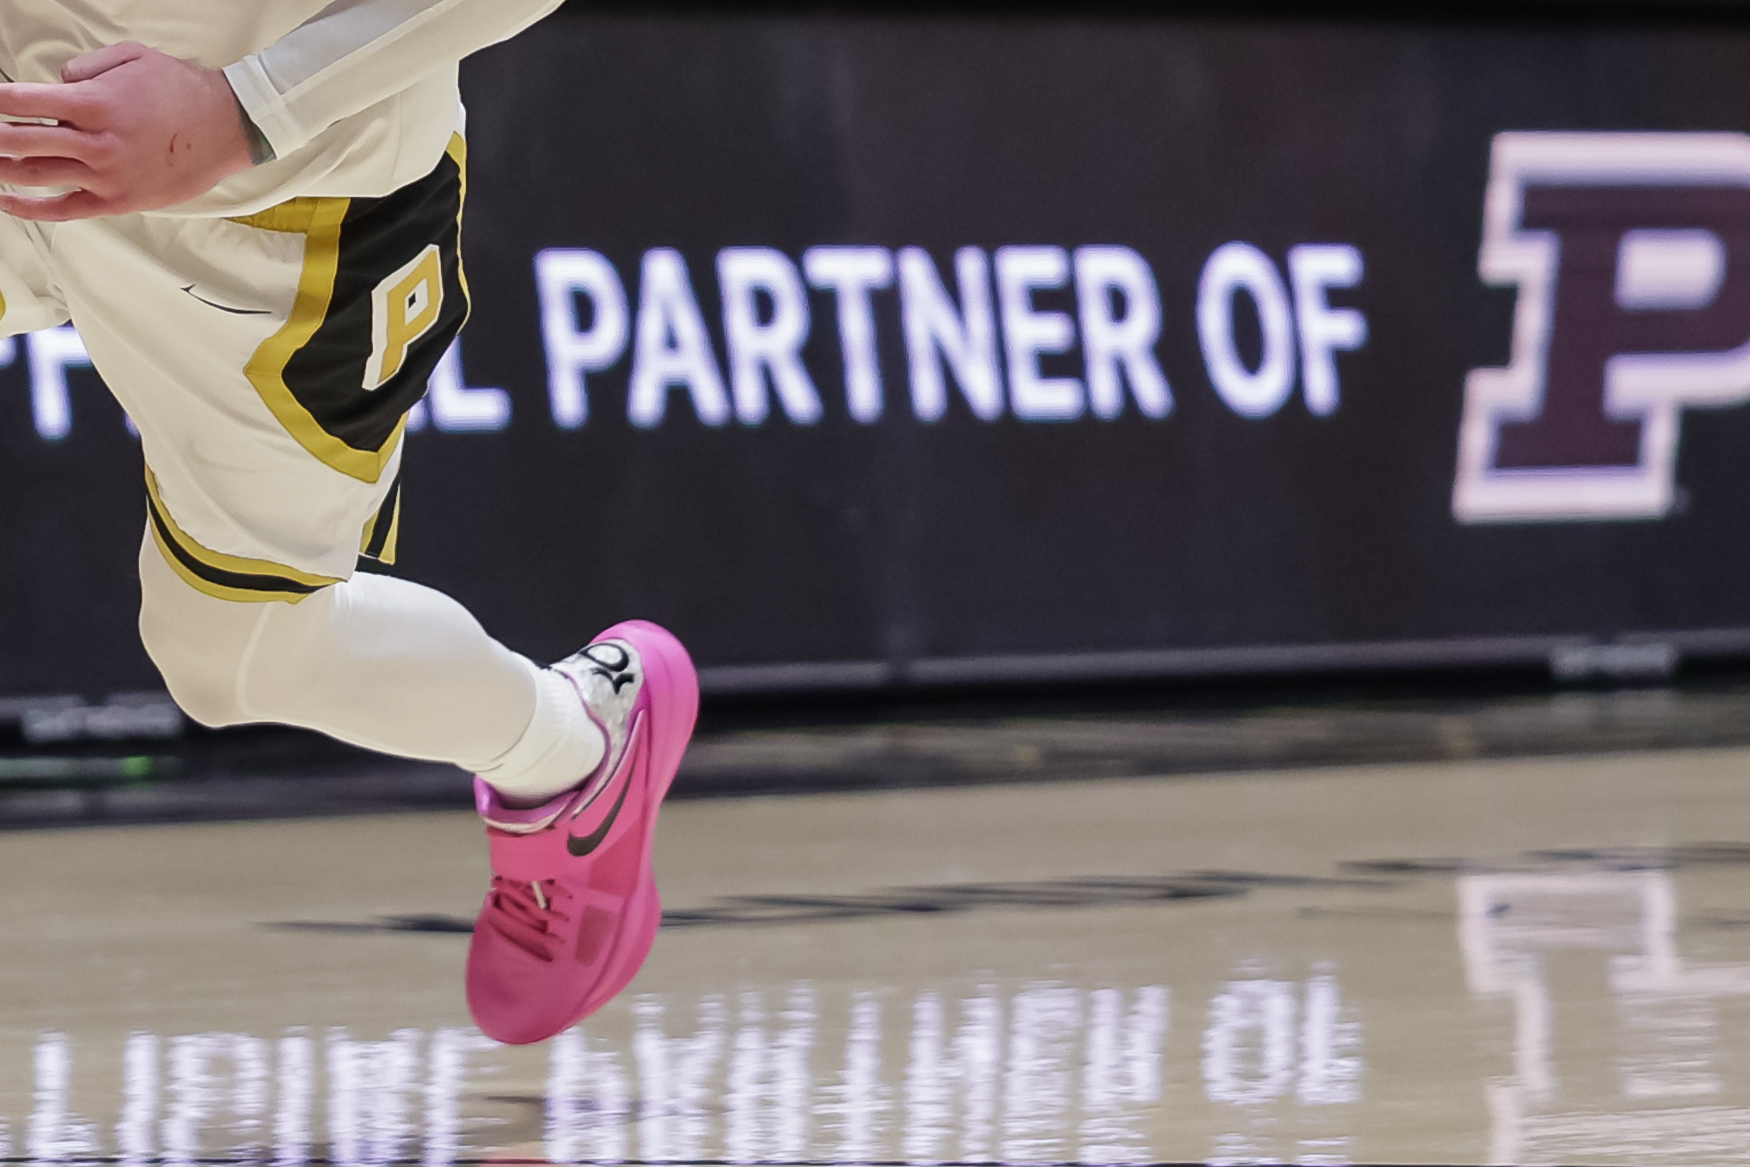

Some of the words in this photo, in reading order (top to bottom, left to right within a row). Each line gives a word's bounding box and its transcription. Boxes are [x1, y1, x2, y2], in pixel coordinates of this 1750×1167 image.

[362, 243, 444, 391] P
[534, 245, 1176, 428] PARTNER
[1195, 241, 1368, 418] OF
